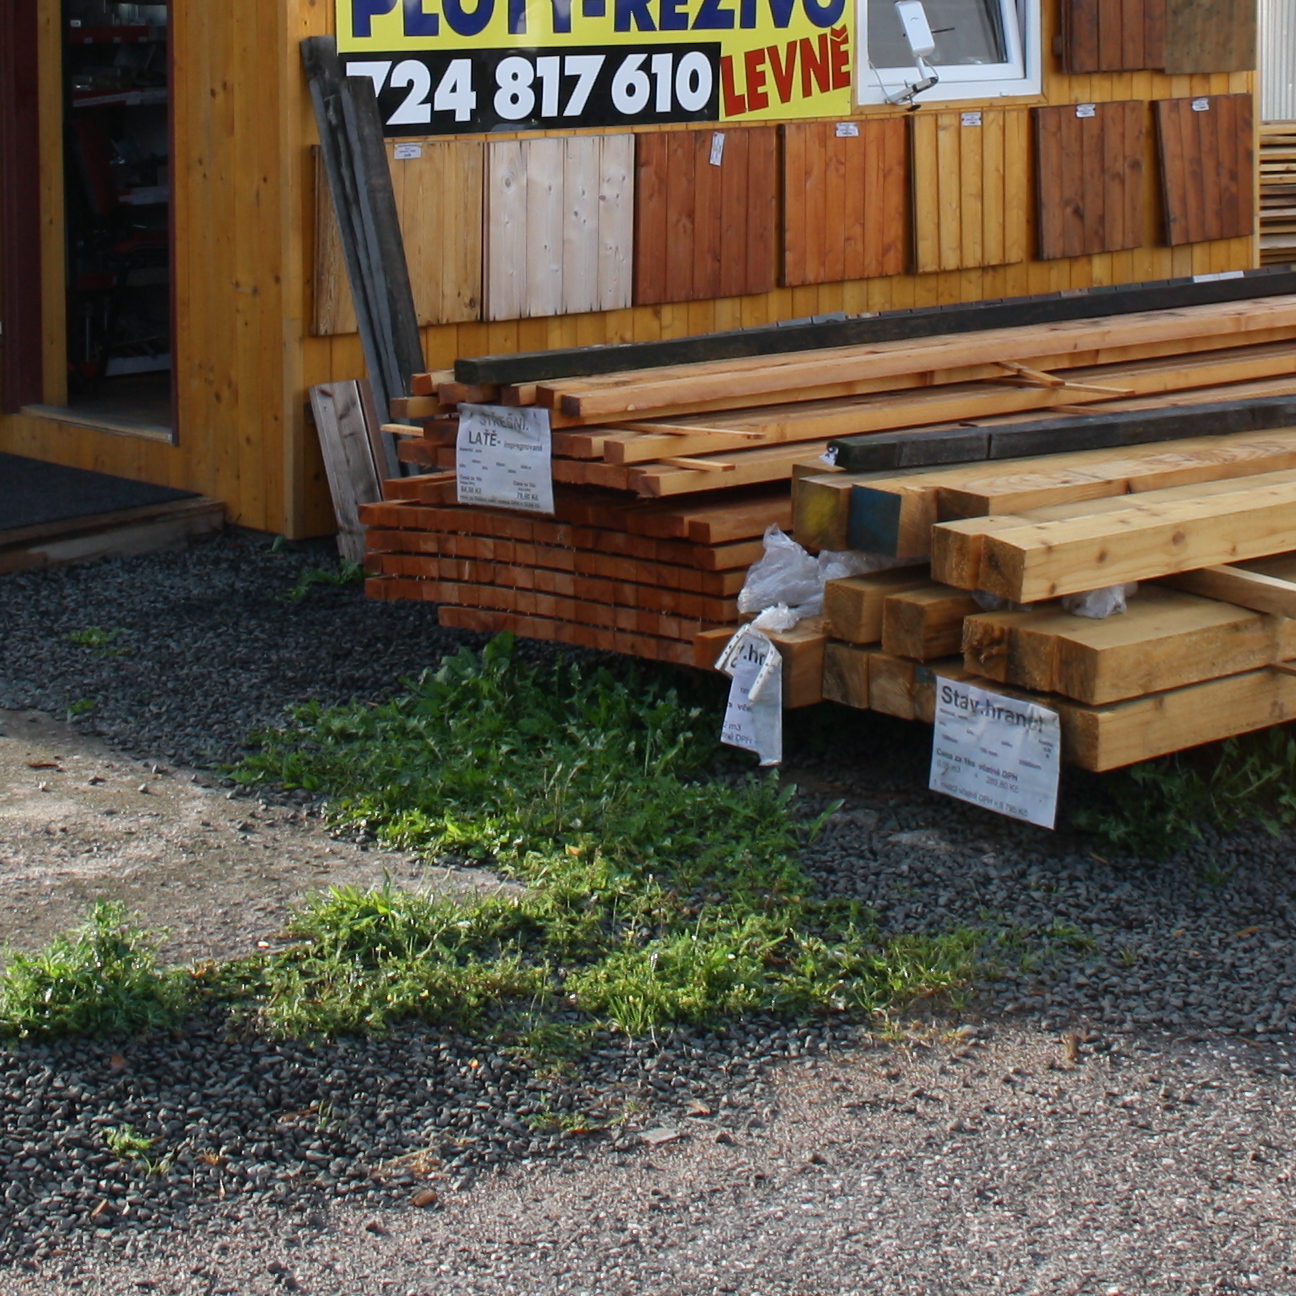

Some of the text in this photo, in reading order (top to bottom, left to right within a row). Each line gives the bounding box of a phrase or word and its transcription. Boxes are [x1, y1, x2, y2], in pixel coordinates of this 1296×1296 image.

[493, 54, 606, 122] 817
[611, 50, 713, 116] 610
[720, 24, 852, 119] LEVNĚ
[1002, 770, 1018, 782] DPH
